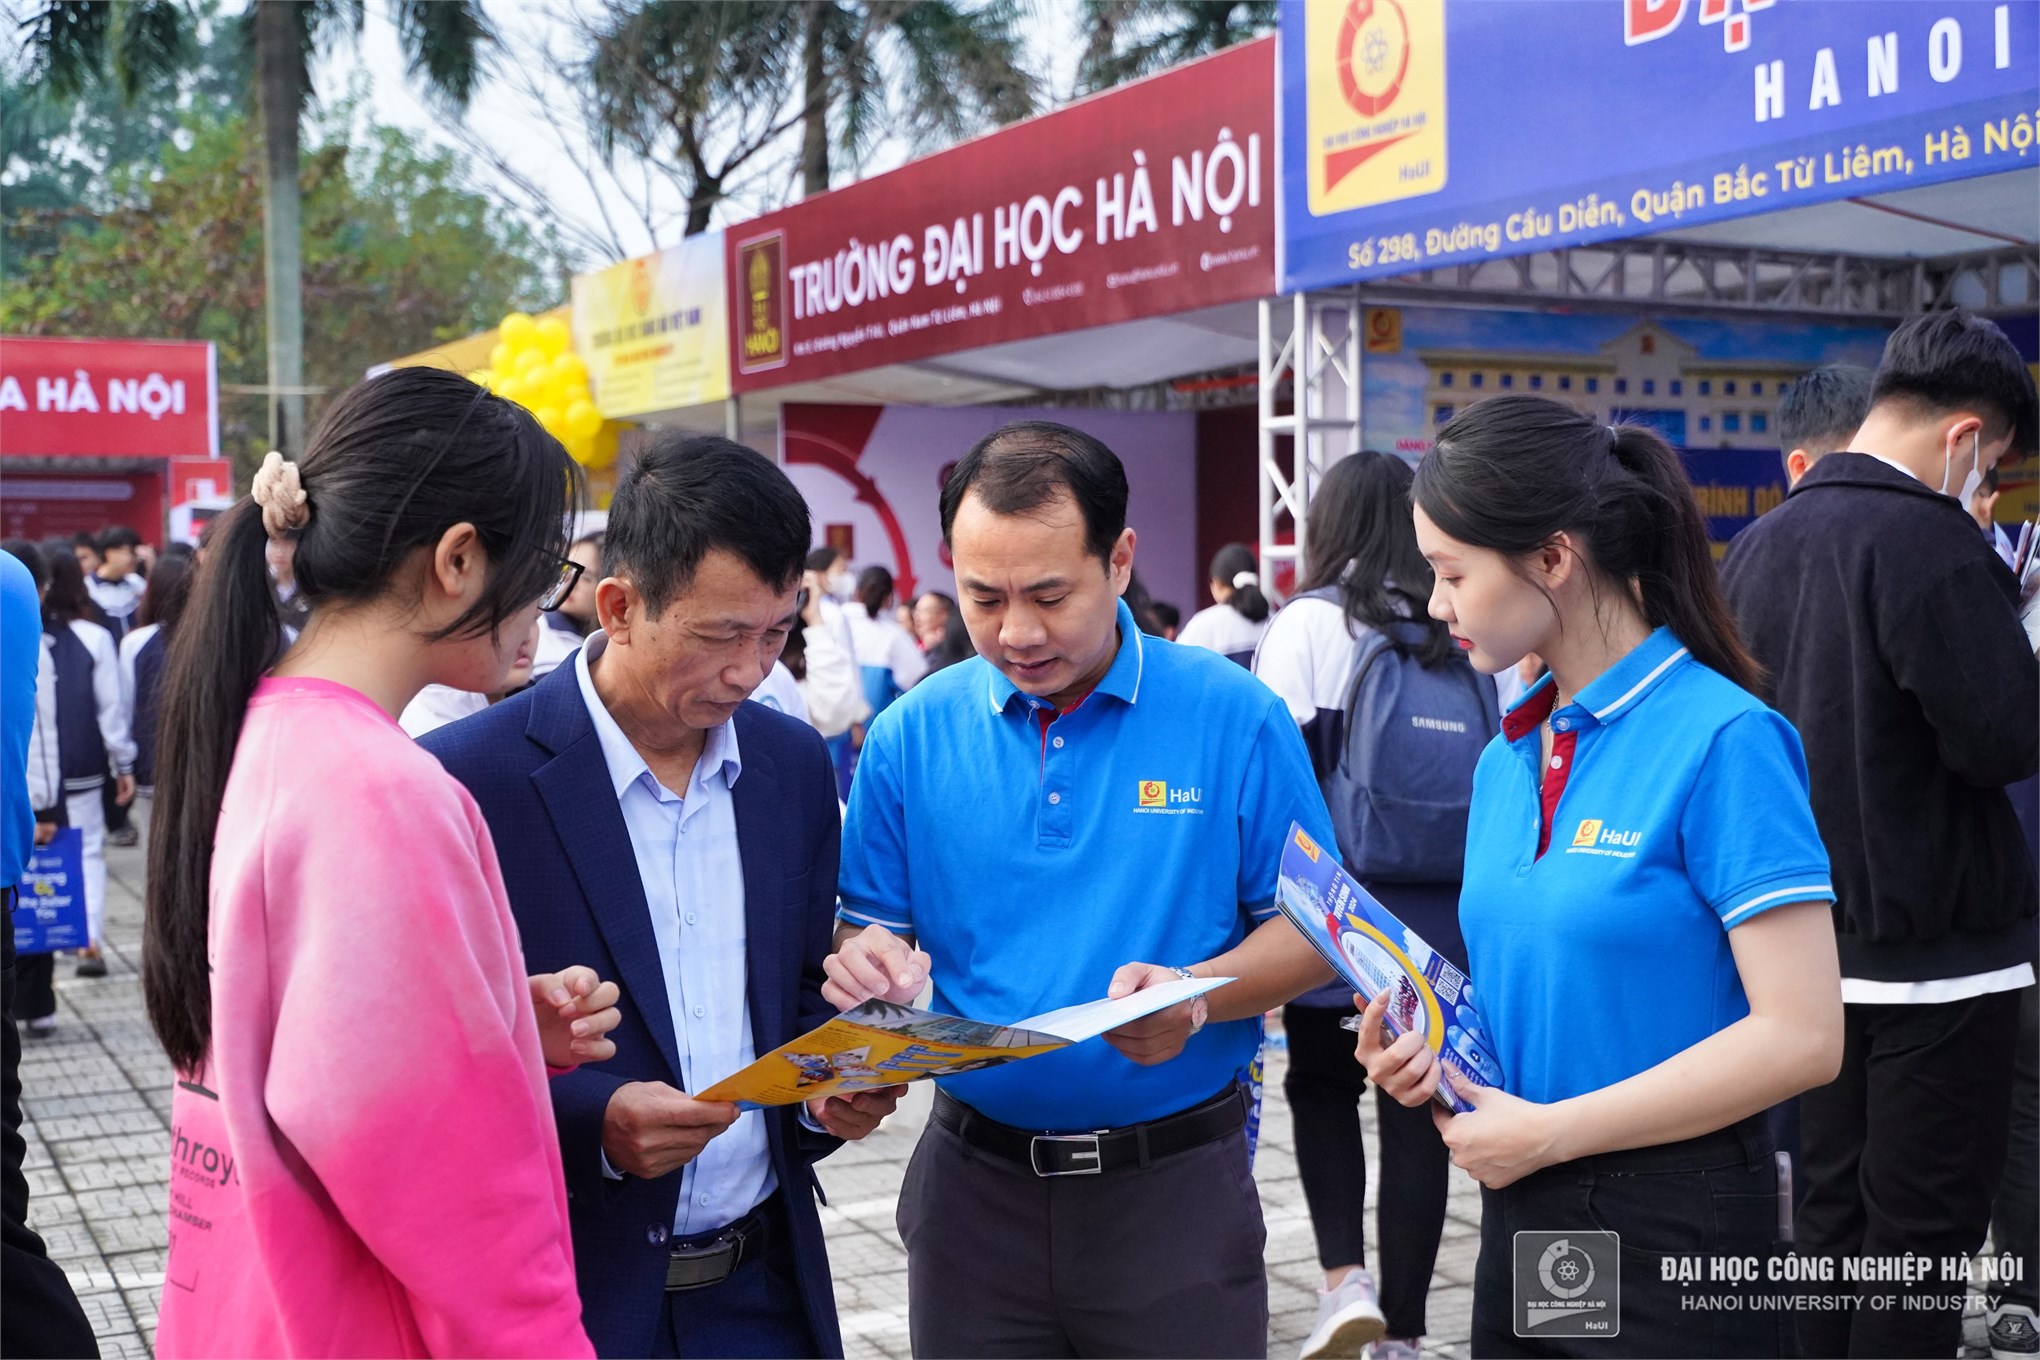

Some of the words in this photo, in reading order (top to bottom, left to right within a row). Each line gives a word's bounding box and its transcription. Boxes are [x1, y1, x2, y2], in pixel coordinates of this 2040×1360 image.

[1754, 4, 2010, 123] HANOI
[789, 234, 916, 320] TRƯỜNG
[922, 213, 984, 294] ĐẠI
[994, 185, 1083, 277] HỌC
[1096, 149, 1158, 245] HÀ
[1172, 126, 1260, 234] NỘI
[1348, 237, 1375, 269] Số
[1377, 232, 1421, 264] 298,
[1424, 222, 1501, 252] Đường
[1630, 181, 1704, 222] Quận
[1713, 163, 1768, 205] Bắc
[1775, 157, 1815, 191] Từ
[1824, 144, 1914, 184] Liêm,
[1924, 126, 1970, 165] Hà
[37, 369, 100, 413] HÀ
[108, 372, 186, 420] NỘI
[1411, 715, 1466, 733] SAMSUNG
[1599, 828, 1642, 846] HaUI
[172, 1124, 240, 1186] hroy
